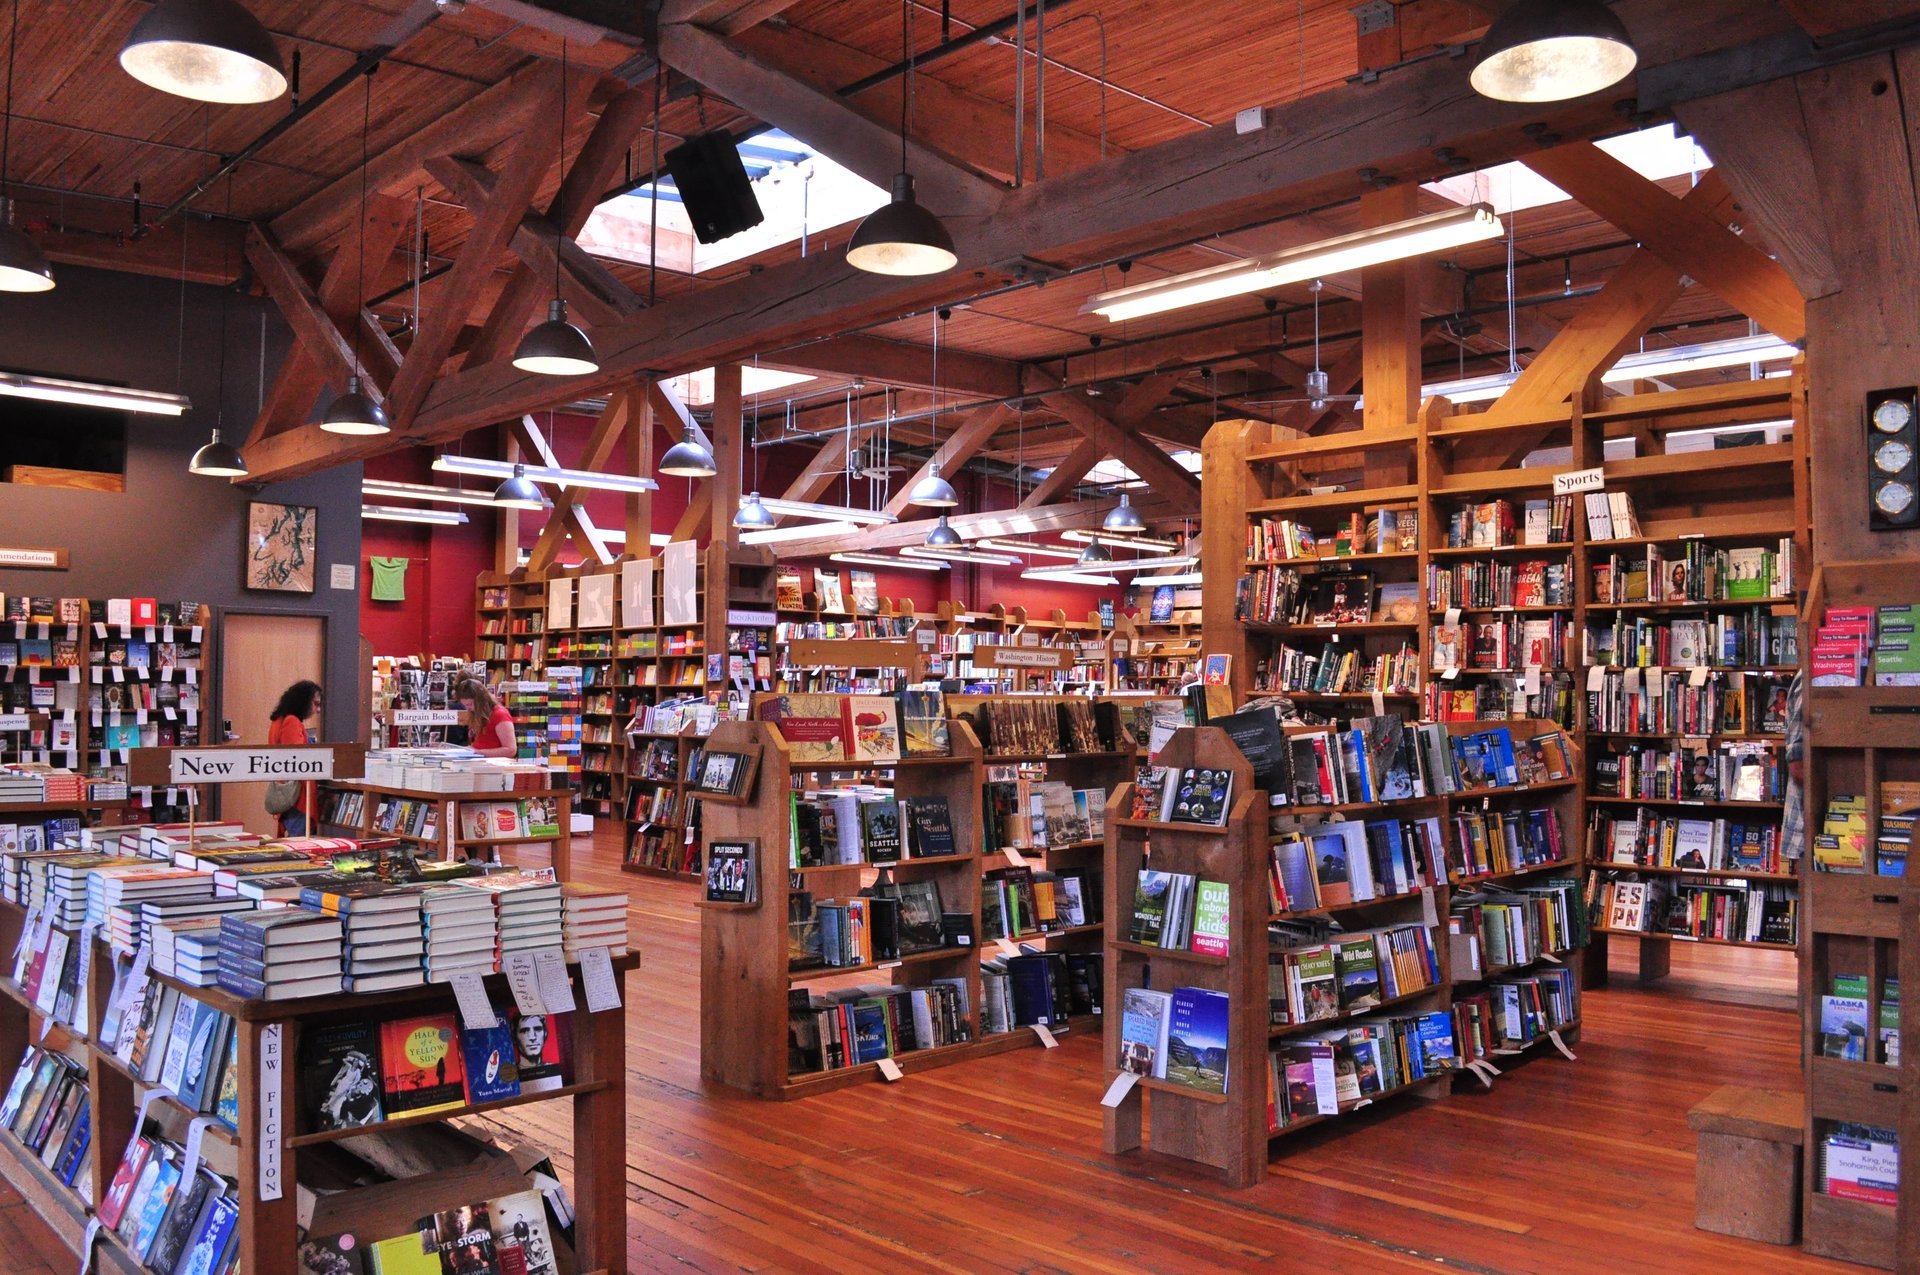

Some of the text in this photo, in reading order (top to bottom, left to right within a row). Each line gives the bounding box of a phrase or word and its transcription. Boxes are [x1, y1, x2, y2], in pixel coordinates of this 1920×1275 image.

[1558, 473, 1600, 490] Sports
[0, 552, 53, 562] mendations
[998, 653, 1056, 664] Washington History
[1813, 662, 1853, 670] Washington
[0, 718, 27, 726] uspense
[397, 713, 456, 724] Bargain Books
[179, 755, 324, 775] New Fiction
[923, 824, 950, 832] Seattle
[1745, 832, 1759, 841] 50
[869, 839, 900, 848] SEATTLE
[725, 846, 743, 854] SECONDS
[1202, 889, 1229, 902] out
[1204, 902, 1229, 913] about
[1198, 916, 1227, 934] kids
[1196, 938, 1224, 948] seattle
[1342, 949, 1373, 962] Wild Roads
[1176, 1000, 1194, 1008] CLASSIC
[1829, 999, 1865, 1009] ALASKA
[414, 1030, 437, 1040] HALF
[410, 1044, 445, 1056] YELLOW
[420, 1055, 437, 1063] SUN
[265, 1028, 278, 1193] NEW FICTION
[1862, 1156, 1881, 1165] King,
[1839, 1160, 1878, 1172] Snohomish
[457, 1232, 492, 1247] STORM
